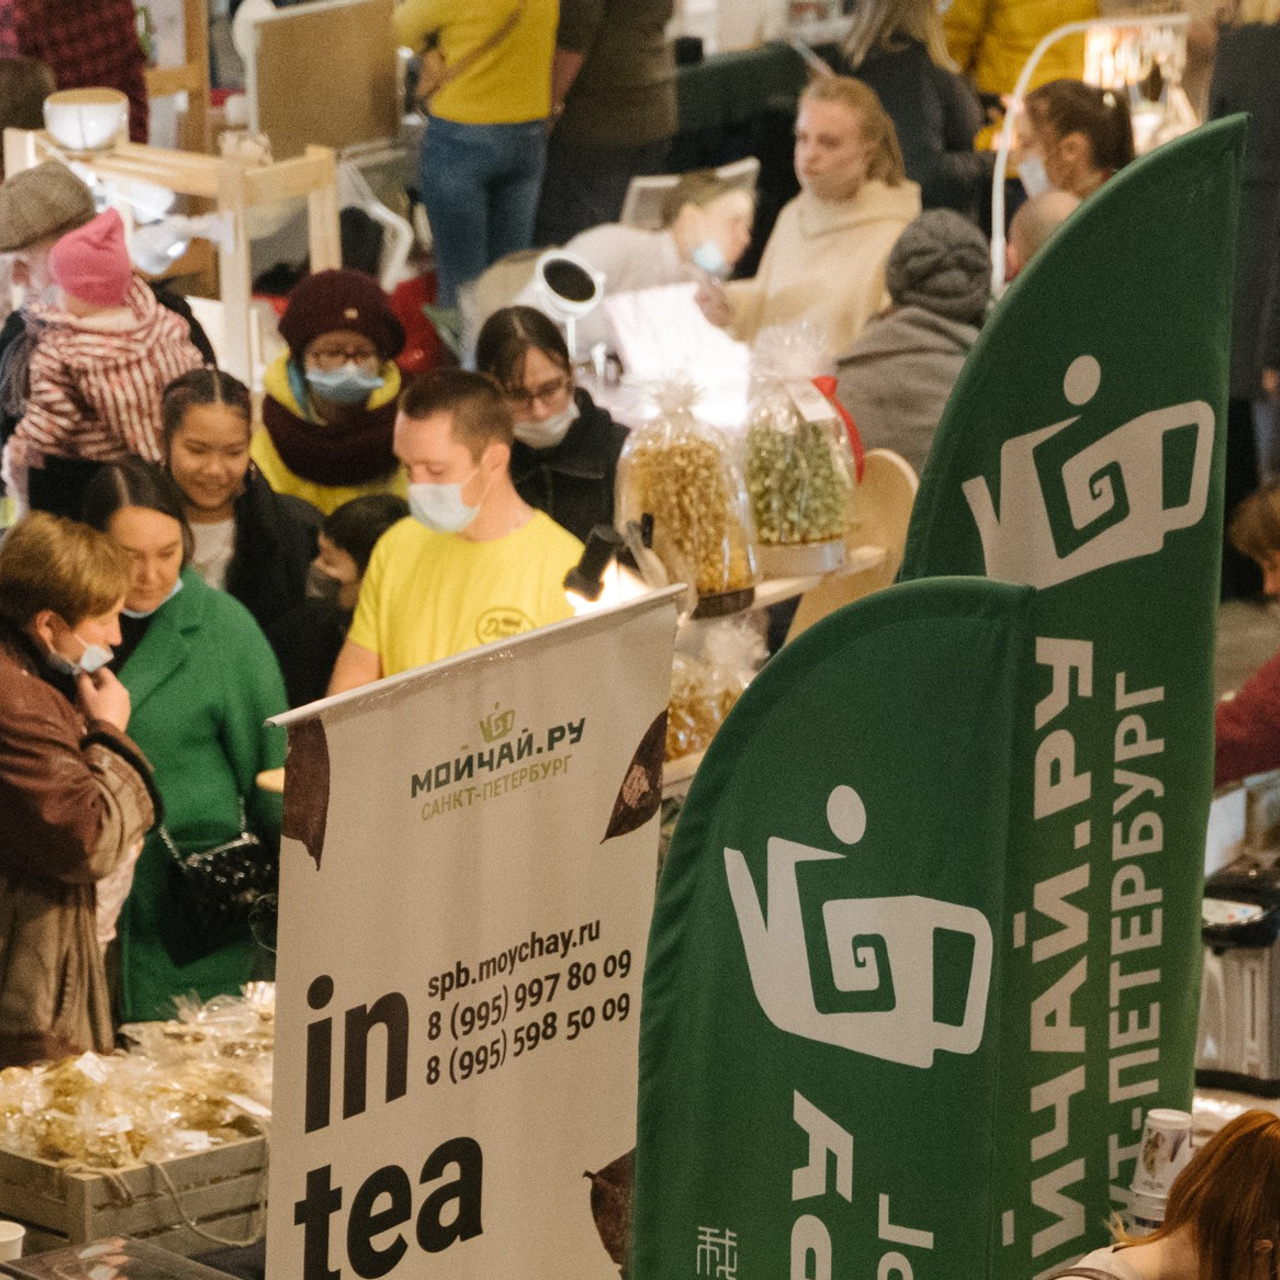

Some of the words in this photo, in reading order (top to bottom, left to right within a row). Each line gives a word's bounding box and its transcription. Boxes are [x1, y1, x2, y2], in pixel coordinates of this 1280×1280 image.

[410, 717, 586, 798] МОЙЧАЙ.РУ
[420, 754, 573, 822] САНКТ-ПЕТЕРБУРГ
[427, 919, 601, 1001] spb.moychay.ru
[427, 1010, 442, 1041] 8
[450, 984, 509, 1041] (995)
[514, 972, 561, 1013] 997
[566, 961, 597, 991] 80
[603, 949, 632, 979] 09
[304, 974, 409, 1135] in
[426, 1055, 441, 1086] 8
[449, 1028, 507, 1085] (995)
[512, 1011, 558, 1058] 598
[565, 1005, 595, 1041] 50
[601, 992, 631, 1022] 09
